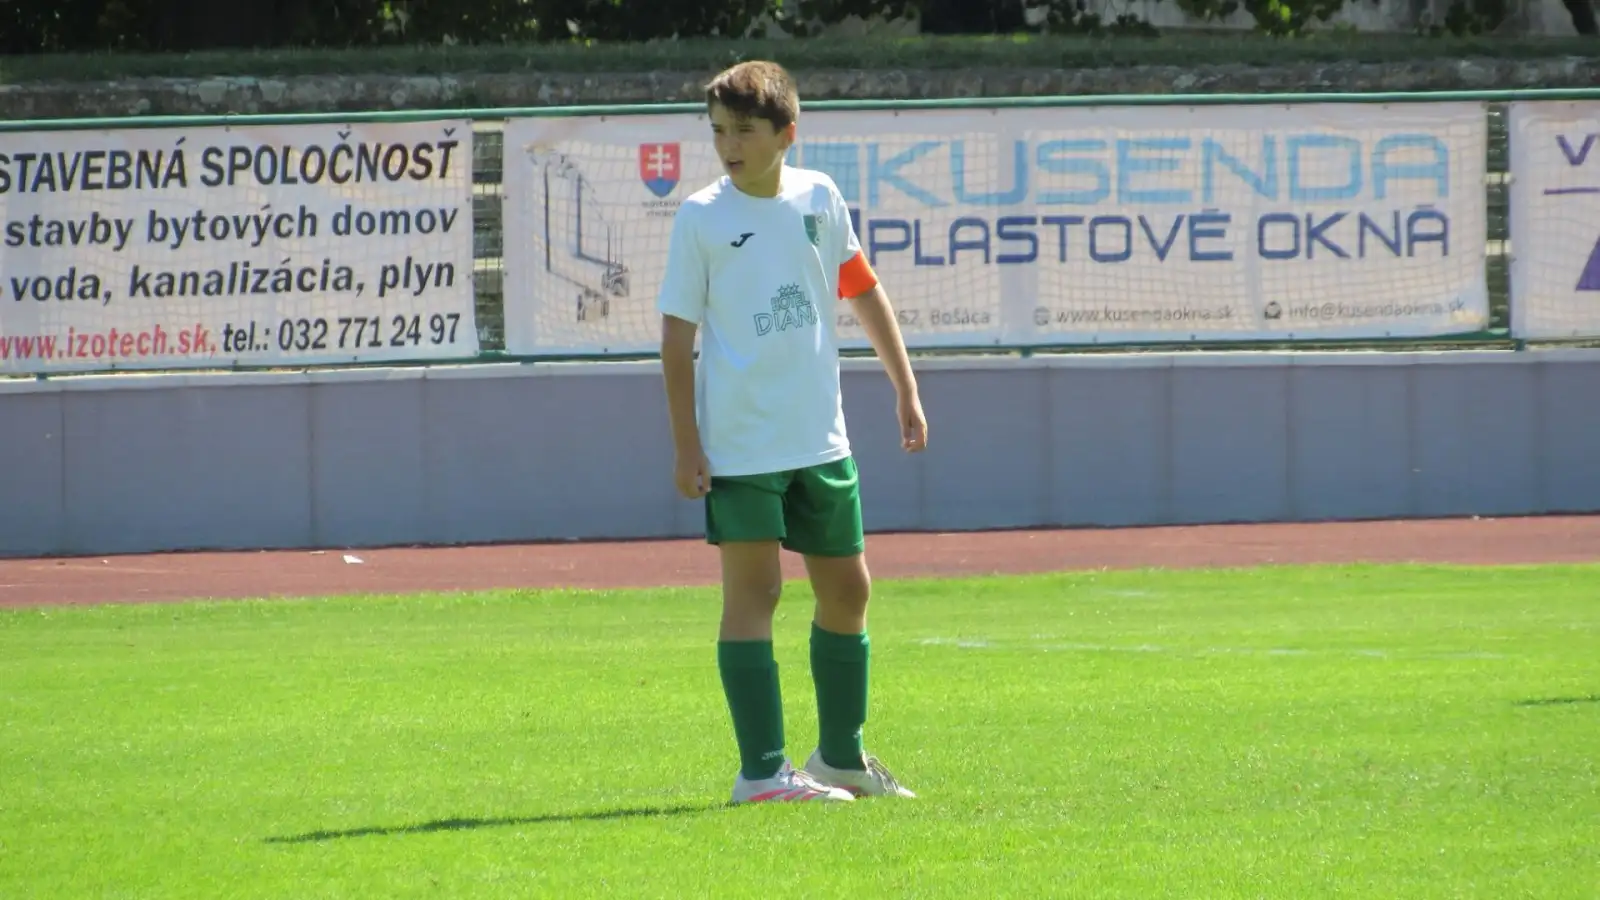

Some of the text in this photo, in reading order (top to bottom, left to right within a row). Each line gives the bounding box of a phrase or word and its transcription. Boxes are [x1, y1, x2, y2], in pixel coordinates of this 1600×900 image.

[200, 127, 459, 187] SPOLOČNOSŤ
[867, 134, 1450, 207] KUSENDA
[4, 203, 458, 251] stavby bytových domov
[10, 256, 455, 306] voda, kanalizácia, plyn
[0, 313, 461, 360] www.izotech.sk, tel.: 032 771 24 97
